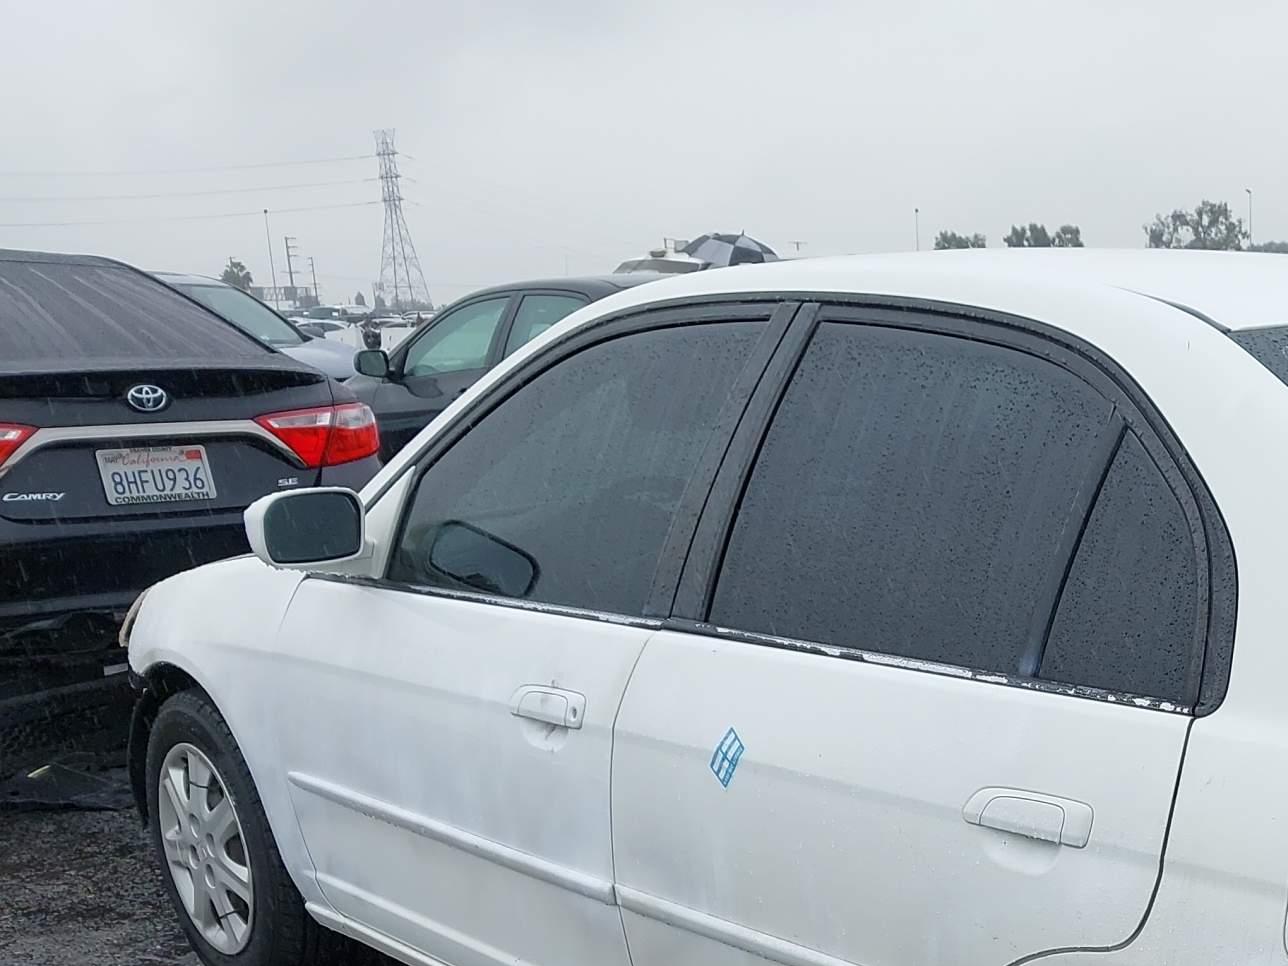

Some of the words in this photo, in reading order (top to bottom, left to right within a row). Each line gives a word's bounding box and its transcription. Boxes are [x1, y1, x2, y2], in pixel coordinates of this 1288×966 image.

[111, 466, 205, 495] 8HFU936
[277, 477, 298, 487] SE
[2, 492, 66, 501] CAMRY
[114, 491, 209, 504] COMMONWEALTH
